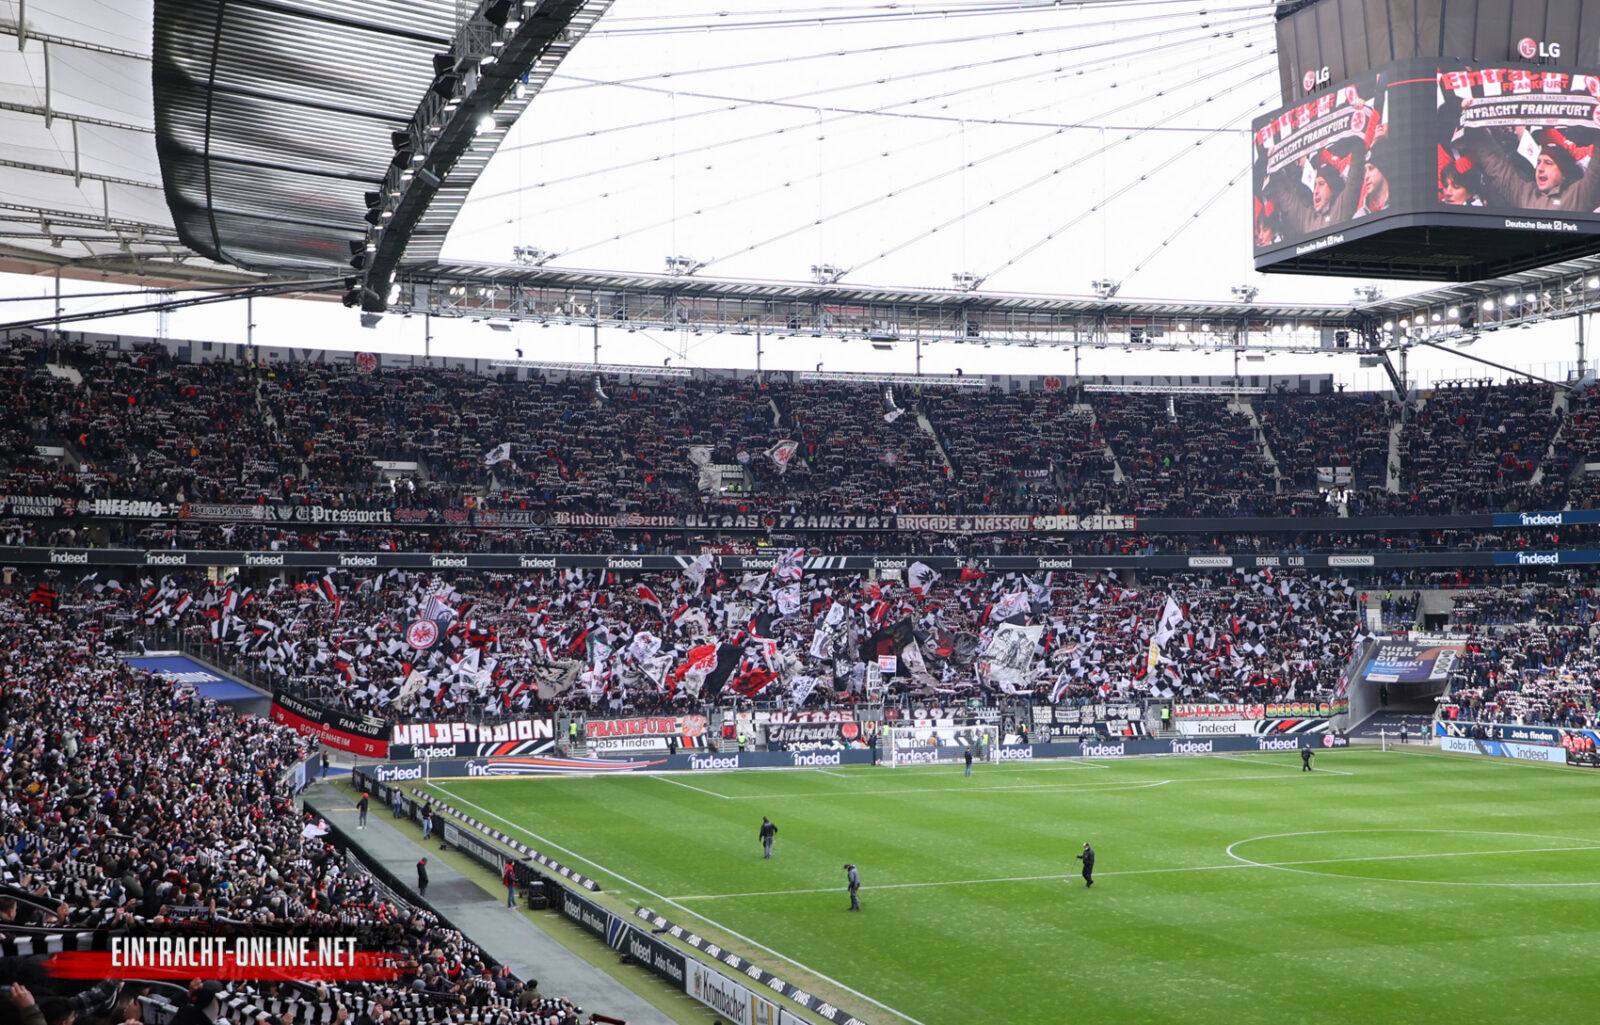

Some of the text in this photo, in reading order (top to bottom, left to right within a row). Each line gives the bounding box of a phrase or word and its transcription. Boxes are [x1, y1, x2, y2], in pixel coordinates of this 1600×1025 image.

[1539, 42, 1561, 58] LG
[1315, 66, 1330, 85] LG
[1521, 104, 1591, 117] FRANKFURT
[1303, 115, 1350, 145] FRANKFURT
[1505, 219, 1579, 231] Deutsche Bank Park
[5, 495, 61, 507] COMMANDO
[12, 506, 56, 516] GIESSEN
[95, 499, 162, 518] INFERNO
[311, 506, 392, 523] Presswerk
[554, 511, 676, 528] Binding Szene
[685, 513, 893, 529] ULTRAS FRANKFURT
[897, 516, 1029, 530] BRIGADE NASSAU
[1521, 513, 1562, 525] indeed
[50, 552, 88, 564] indeed
[147, 553, 187, 565] indeed
[245, 554, 284, 565] indeed
[340, 555, 377, 566] indeed
[432, 556, 468, 567] indeed
[521, 557, 556, 567] indeed
[608, 558, 643, 568] indeed
[742, 558, 776, 569] indeed
[874, 557, 907, 568] indeed
[956, 558, 990, 568] ind
[1039, 558, 1072, 568] indeed
[1255, 556, 1304, 566] BEMBEL CLUB
[1519, 552, 1559, 564] indeed
[280, 694, 380, 736] EINTRACHT FAN-CLUB
[393, 719, 553, 745] WALDSTADION
[586, 718, 677, 737] FRANKFURT
[768, 723, 840, 742] Eintracht
[1198, 719, 1237, 734] indeed
[299, 723, 351, 746] SOSSENHEIM
[364, 743, 375, 753] 75
[622, 737, 655, 748] finden
[1511, 730, 1529, 739] Jobs
[1530, 731, 1554, 741] finden
[1082, 743, 1125, 756] indeed
[1172, 740, 1213, 753] indeed
[1259, 737, 1299, 750] indeed
[1450, 740, 1467, 750] Jobs
[413, 744, 457, 758] indeed
[989, 746, 1033, 760] indeed
[1517, 747, 1550, 761] indeed
[691, 755, 739, 769] indeed
[794, 752, 841, 766] indeed
[377, 765, 422, 782] indeed
[564, 896, 581, 920] indeed
[591, 914, 605, 933] finden
[630, 934, 682, 981] indeed Jobs finden
[705, 944, 721, 958] DWS
[724, 954, 741, 968] DWS
[746, 965, 763, 980] DWS
[767, 977, 785, 992] DWS
[703, 970, 746, 1024] Krombacher
[791, 989, 810, 1005] DWS
[816, 1003, 838, 1019] DWS
